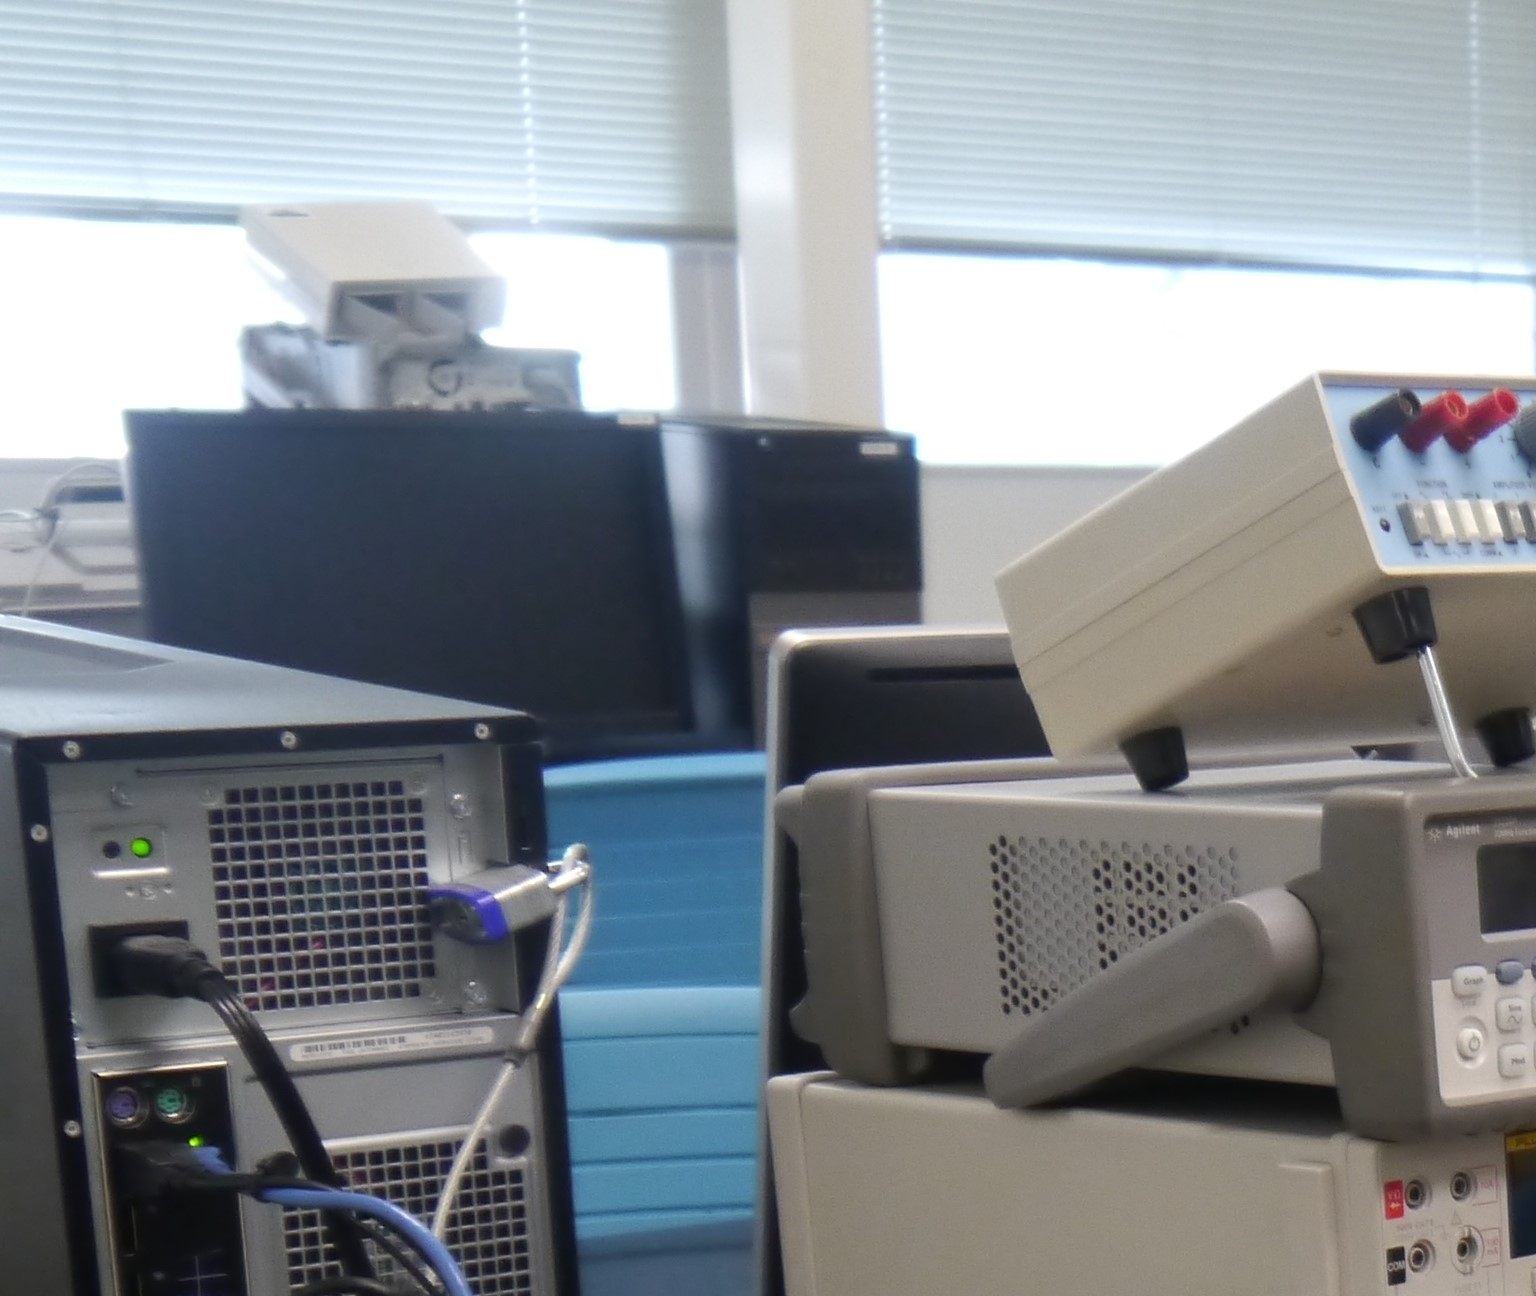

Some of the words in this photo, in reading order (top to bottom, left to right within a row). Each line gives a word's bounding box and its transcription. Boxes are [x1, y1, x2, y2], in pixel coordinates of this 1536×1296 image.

[1446, 822, 1481, 839] Agilent
[1463, 976, 1485, 986] Graph
[1511, 1056, 1526, 1065] Mod
[1387, 1260, 1406, 1272] COM
